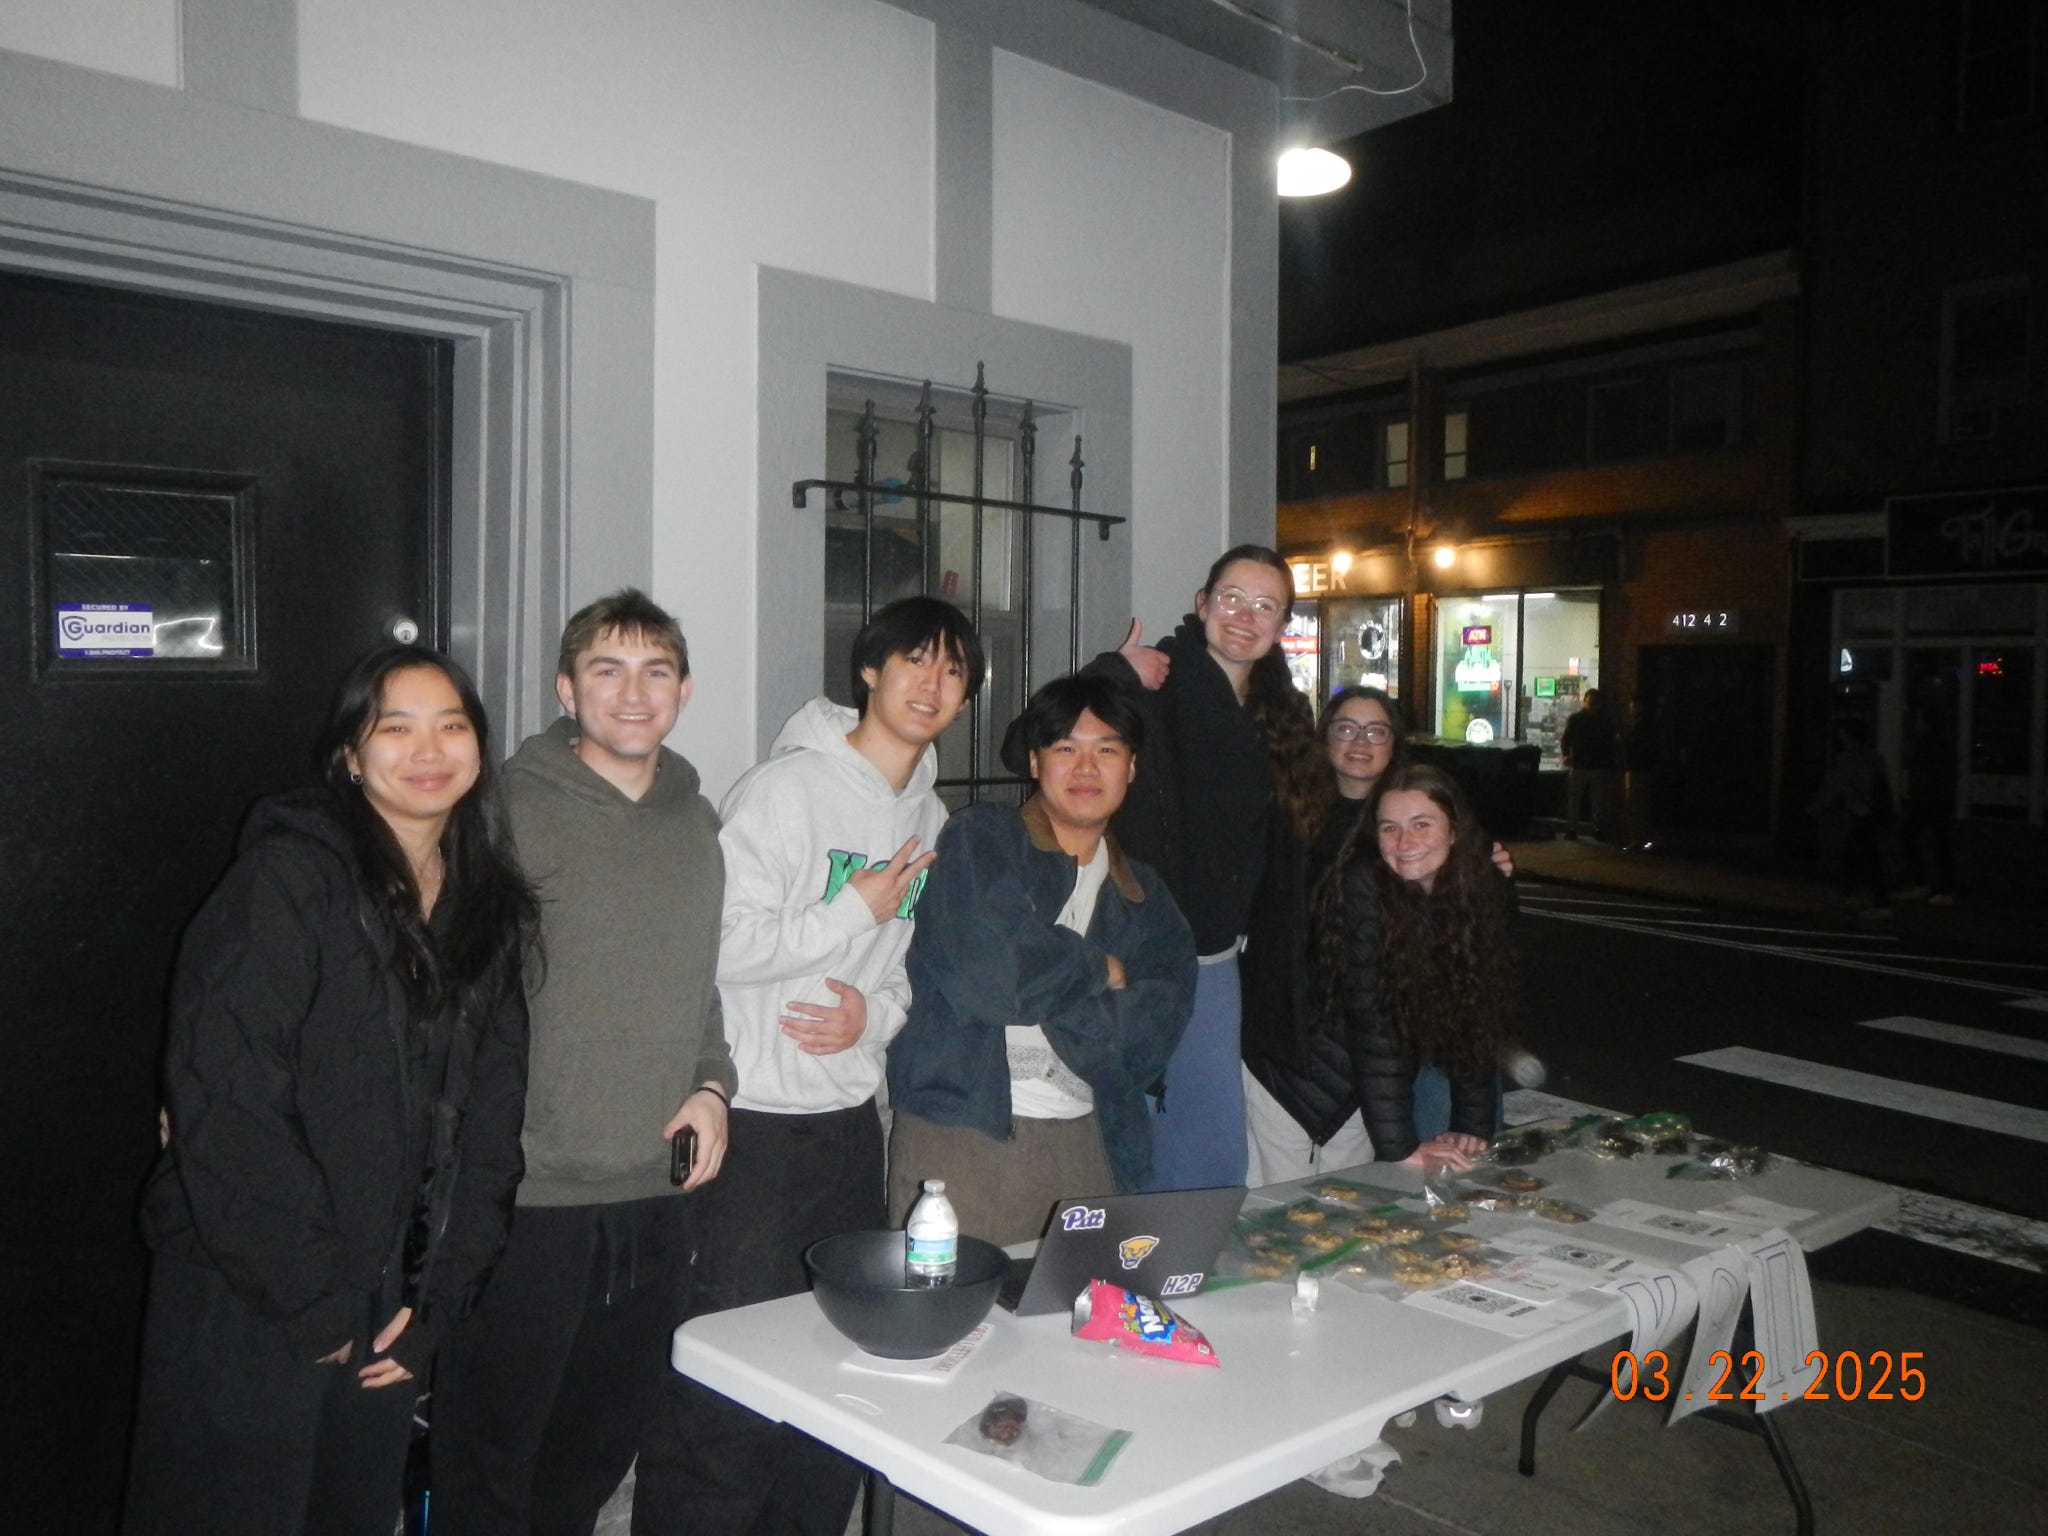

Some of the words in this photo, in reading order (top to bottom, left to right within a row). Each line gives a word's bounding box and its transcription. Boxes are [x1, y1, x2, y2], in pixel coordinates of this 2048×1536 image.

[1292, 563, 1347, 593] EER
[81, 603, 117, 611] SECURED
[119, 603, 129, 611] BY
[64, 618, 150, 637] Guardian
[1063, 1206, 1105, 1230] Pitt
[1162, 1273, 1203, 1295] H2P
